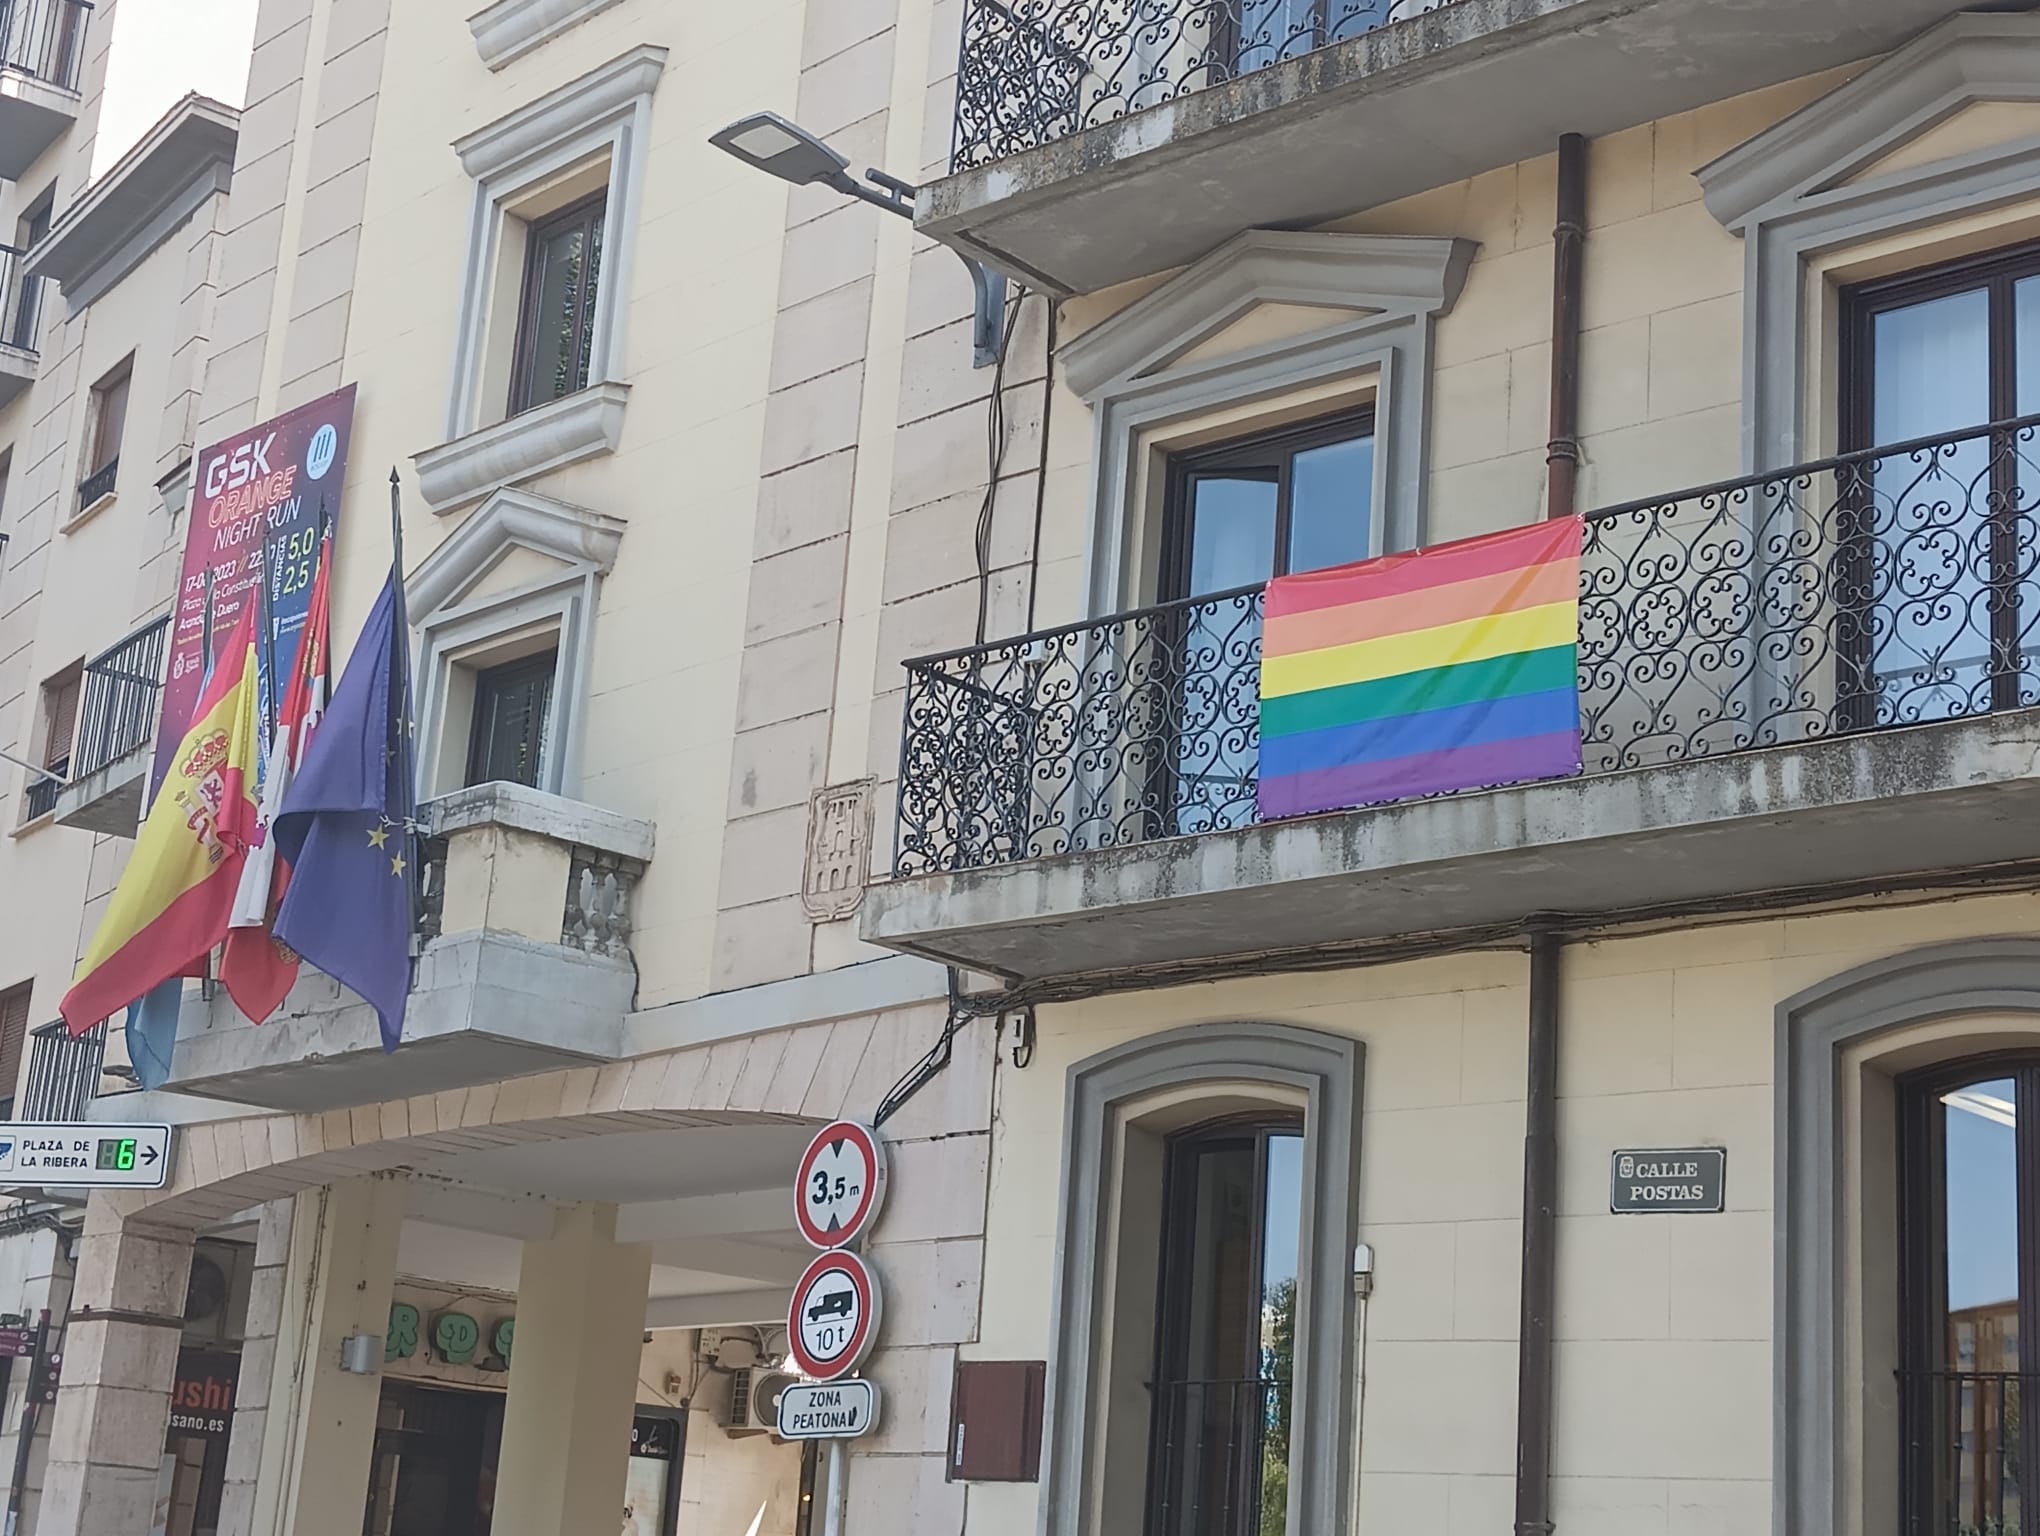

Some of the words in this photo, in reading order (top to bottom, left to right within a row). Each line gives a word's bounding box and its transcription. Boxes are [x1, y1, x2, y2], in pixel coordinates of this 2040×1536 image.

[205, 431, 277, 499] GSK
[208, 465, 297, 529] ORANGE
[213, 511, 263, 552] NIGHT
[266, 495, 302, 529] RUN
[23, 1140, 63, 1151] PLAZA
[73, 1140, 90, 1152] DE
[118, 1139, 135, 1169] 6
[21, 1157, 37, 1167] LA
[43, 1156, 88, 1168] RIBERA
[1636, 1162, 1698, 1178] CALLE
[811, 1170, 846, 1206] 3,5
[849, 1184, 860, 1197] m
[1630, 1184, 1704, 1201] POSTAS
[816, 1327, 834, 1352] 10
[838, 1325, 845, 1343] t
[808, 1390, 842, 1408] ZONA
